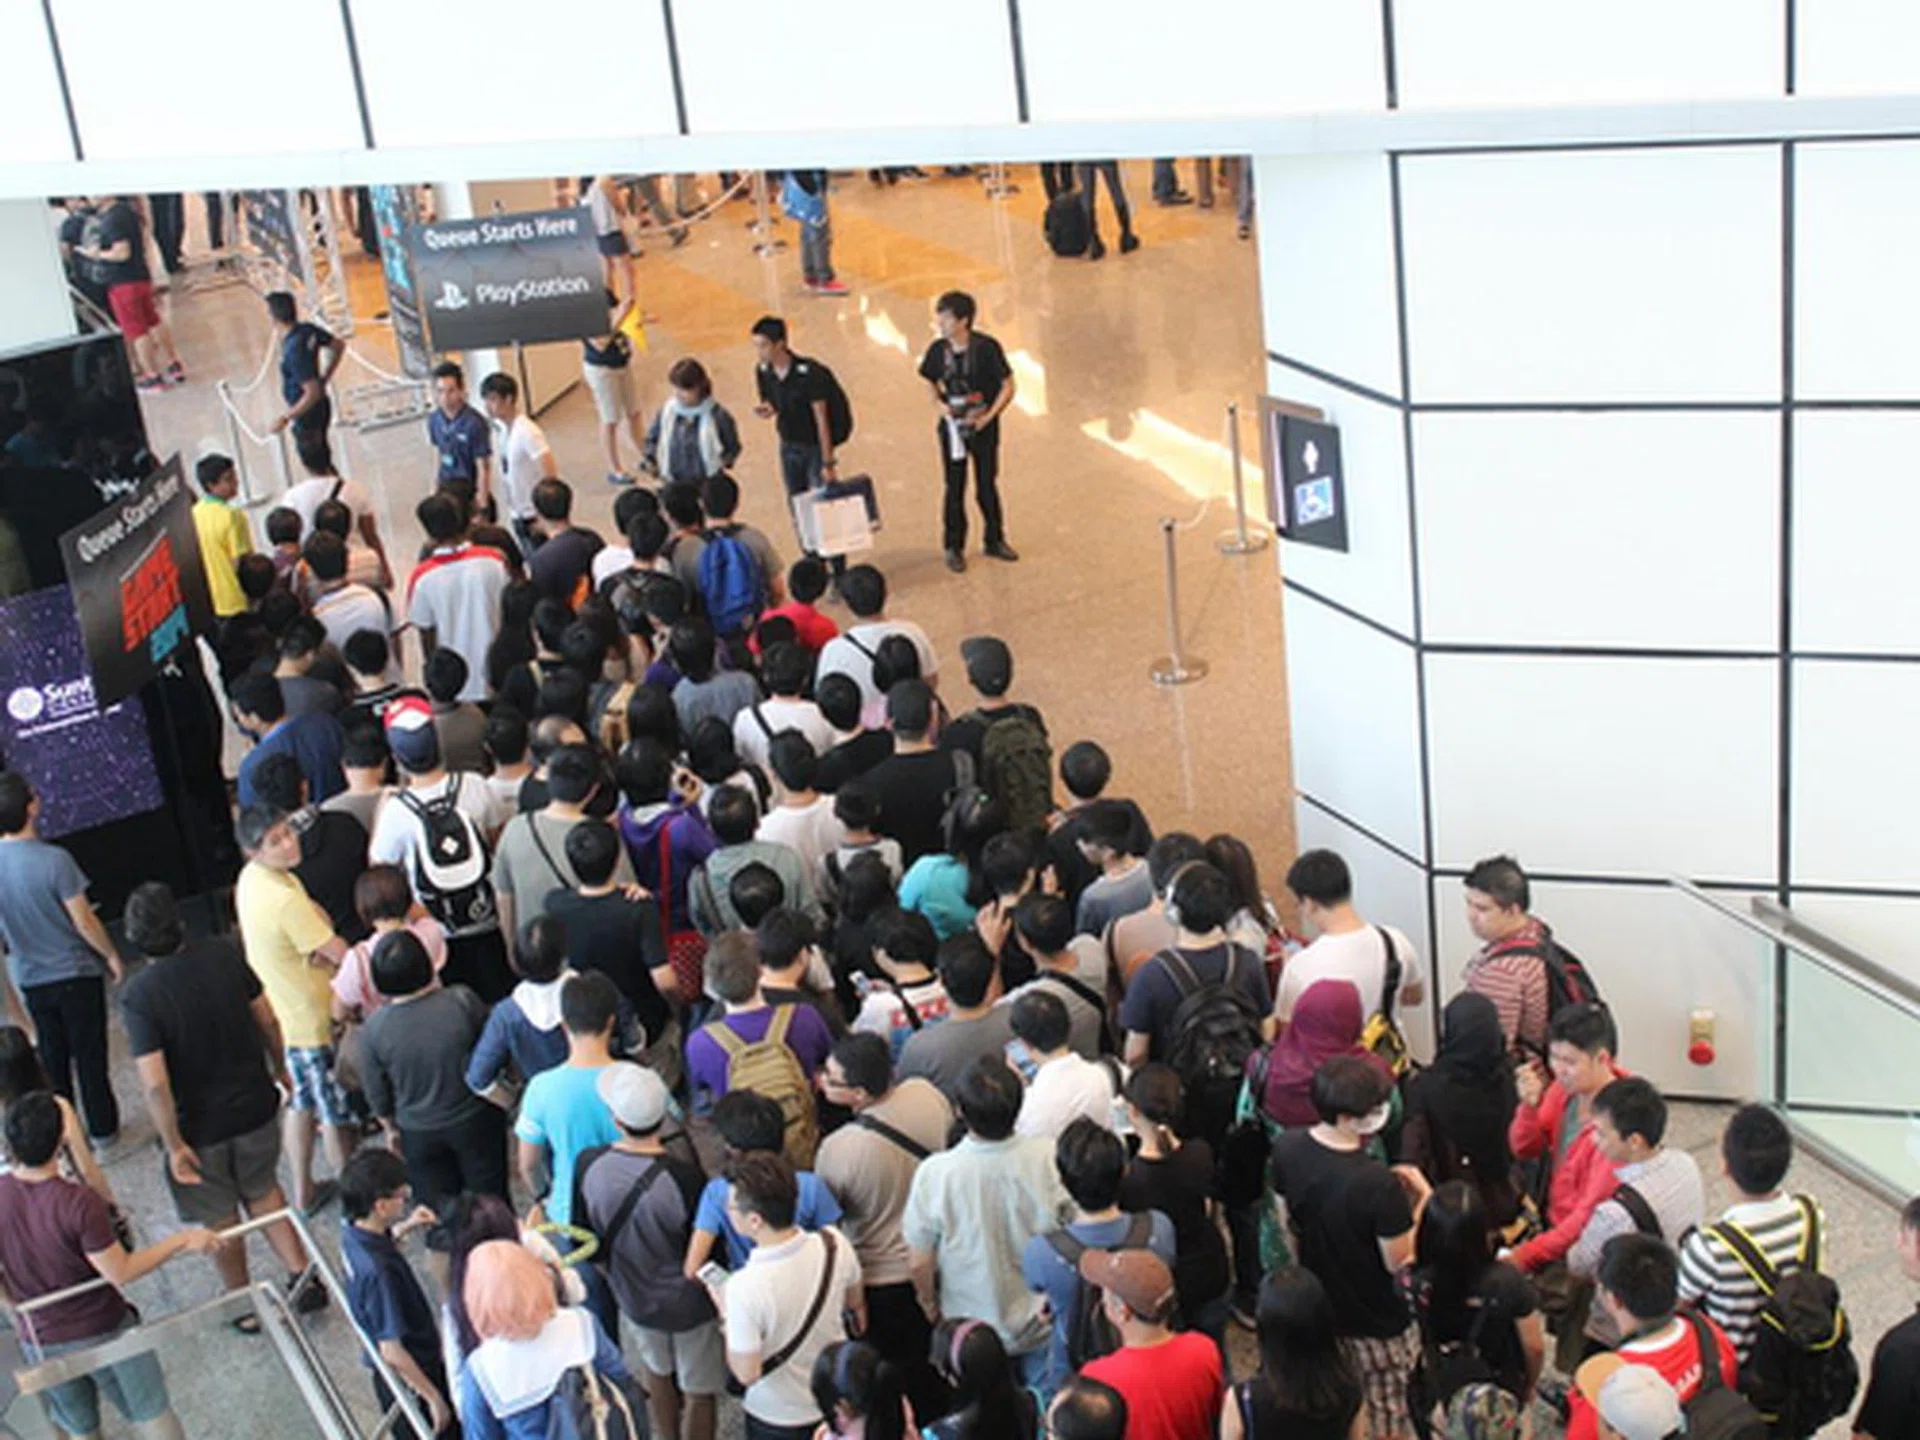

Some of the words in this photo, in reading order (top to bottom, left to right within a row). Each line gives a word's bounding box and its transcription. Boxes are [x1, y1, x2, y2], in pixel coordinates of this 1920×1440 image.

[424, 228, 478, 250] Queue
[480, 223, 534, 243] Starts
[535, 216, 577, 235] Here
[476, 277, 589, 307] PlayStation
[78, 520, 124, 562] Queue
